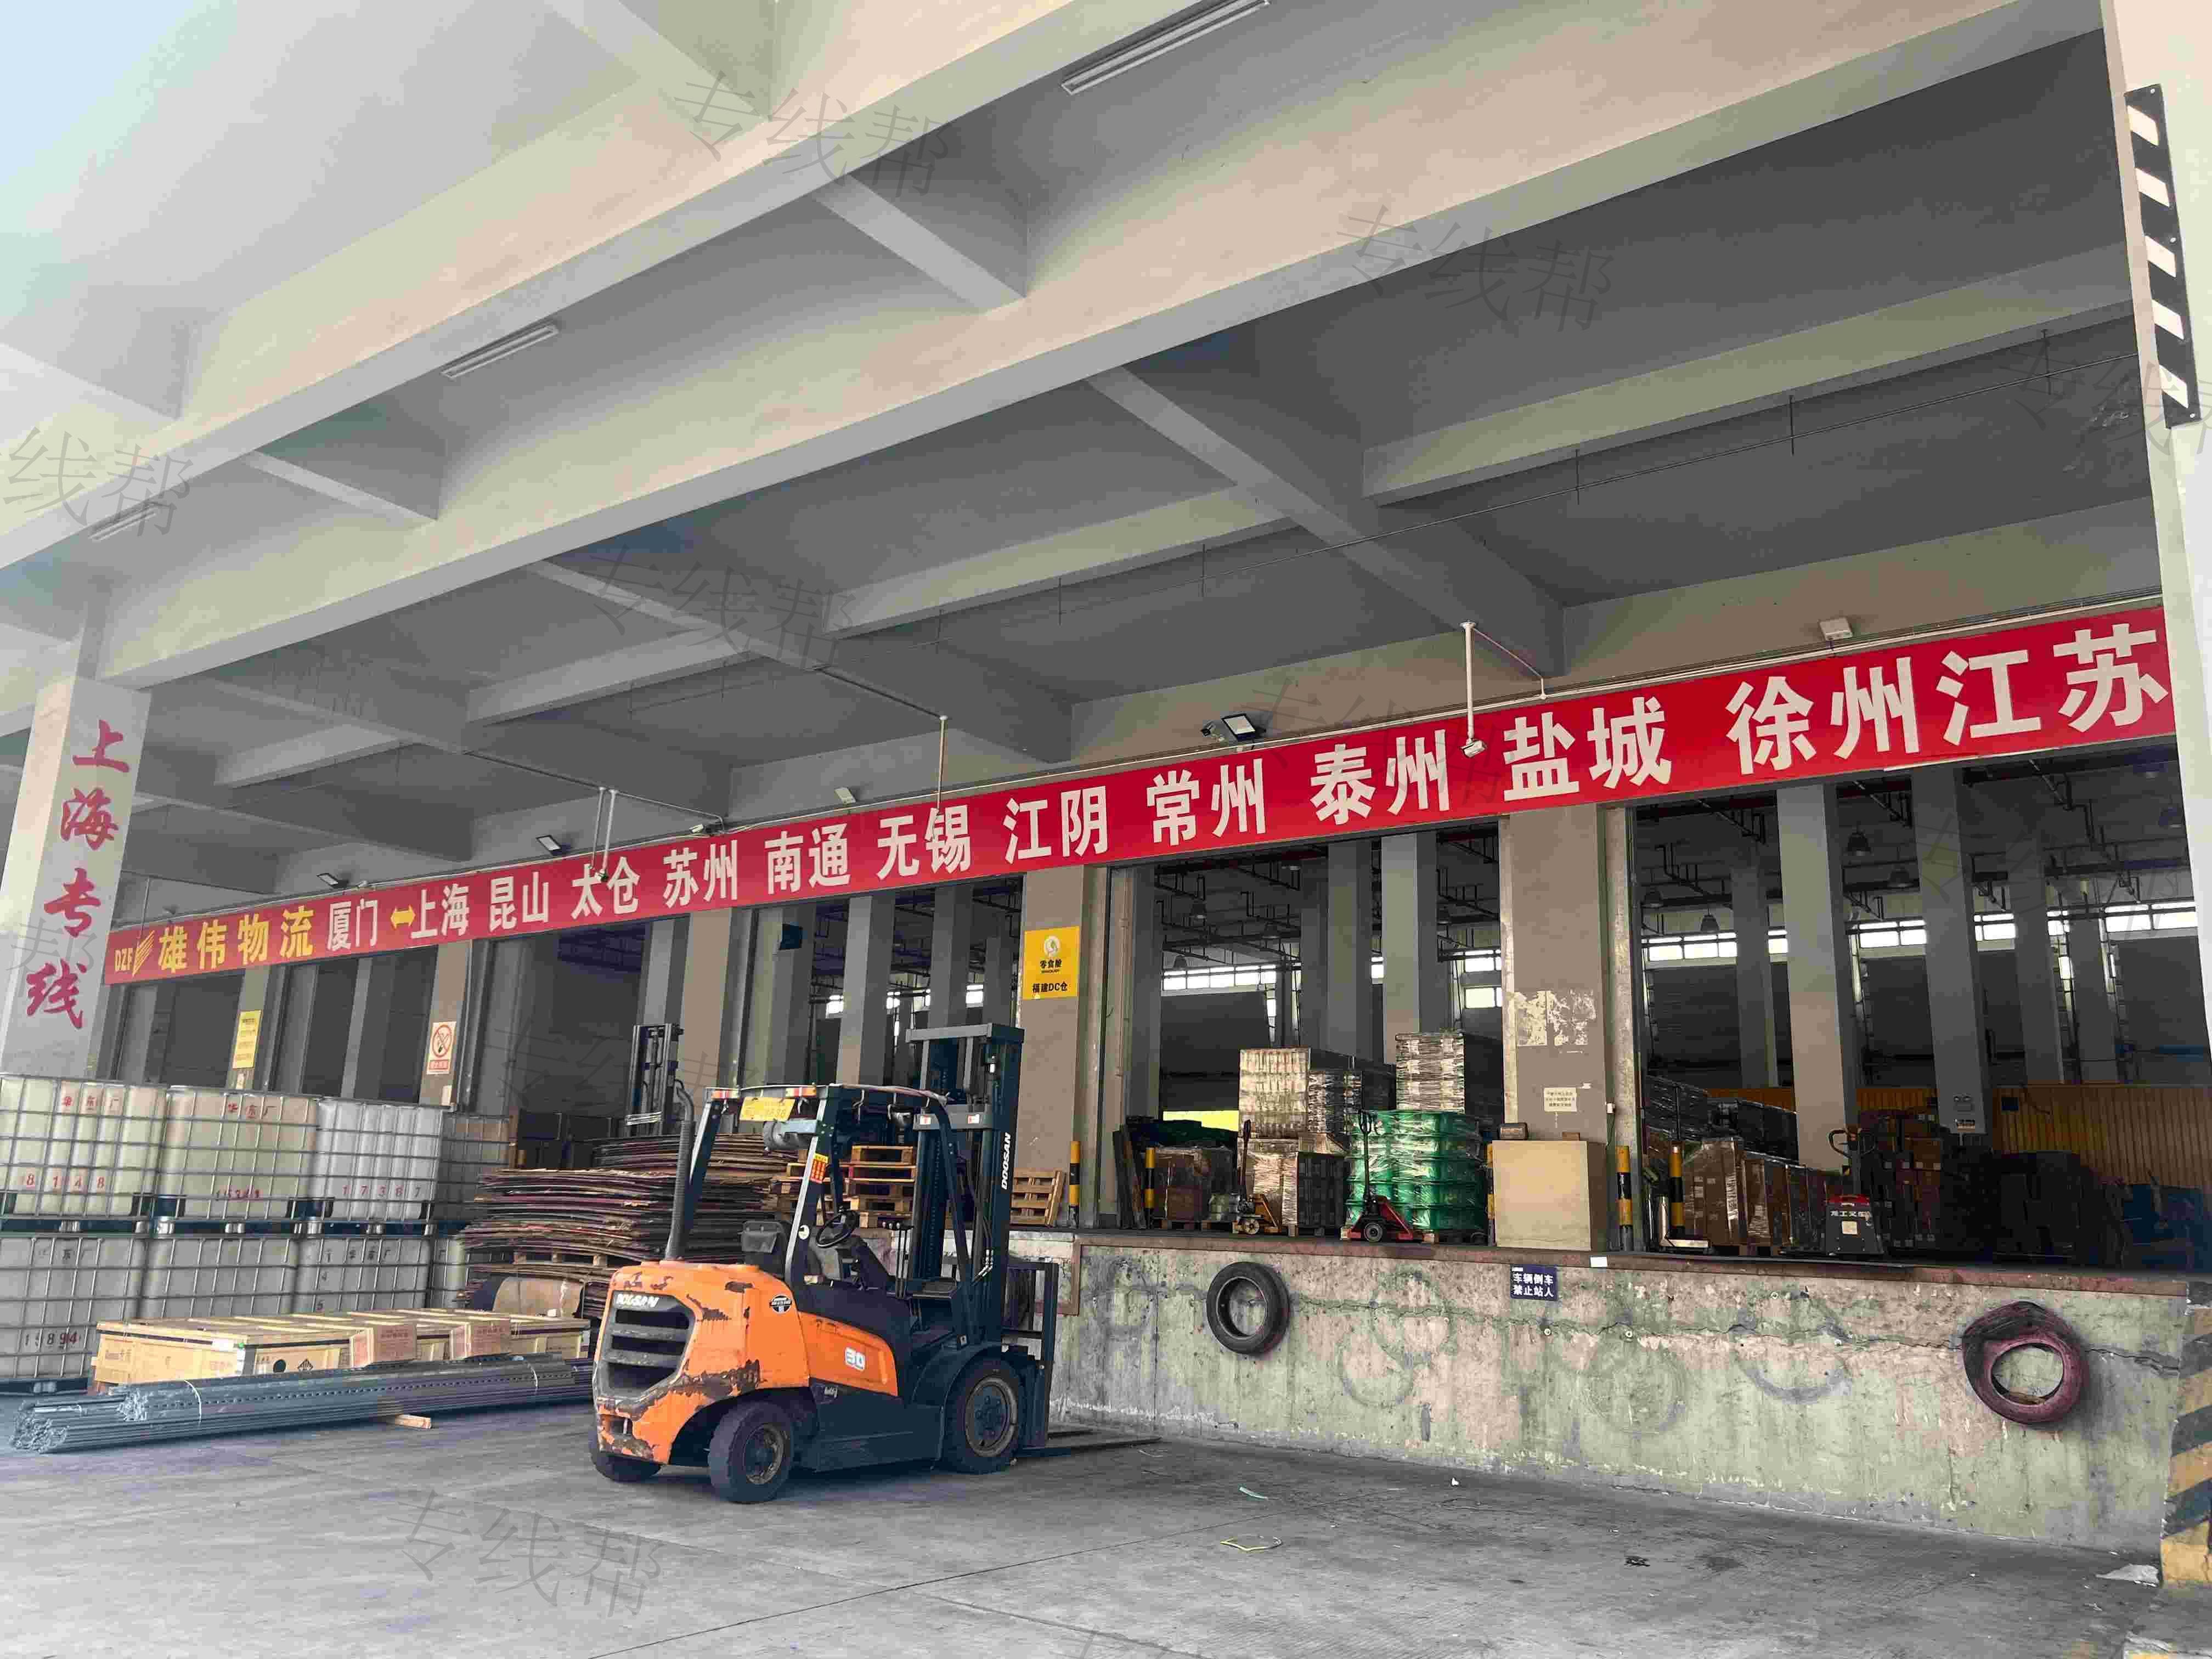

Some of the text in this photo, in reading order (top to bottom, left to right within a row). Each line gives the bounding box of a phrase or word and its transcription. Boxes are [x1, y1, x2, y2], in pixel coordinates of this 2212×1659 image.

[157, 905, 314, 974] 雄伟物流
[327, 898, 379, 952] 厦门
[410, 884, 470, 939] 上海
[488, 872, 550, 932] 昆山
[571, 856, 640, 920] 太仓
[663, 839, 738, 909] 苏州
[764, 823, 851, 895] 南通
[877, 804, 972, 880] 无锡
[1003, 785, 1108, 865] 江阴
[1146, 759, 1266, 847] 常州
[1310, 729, 1451, 825] 泰州
[1503, 696, 1672, 802] 盐城
[26, 719, 130, 1030] 上海专线
[1032, 981, 1069, 992] 福建DC仓
[1001, 1132, 1011, 1190] DOOSAN
[1513, 1273, 1554, 1286] 车辆倒车
[1513, 1284, 1554, 1297] 禁止站人
